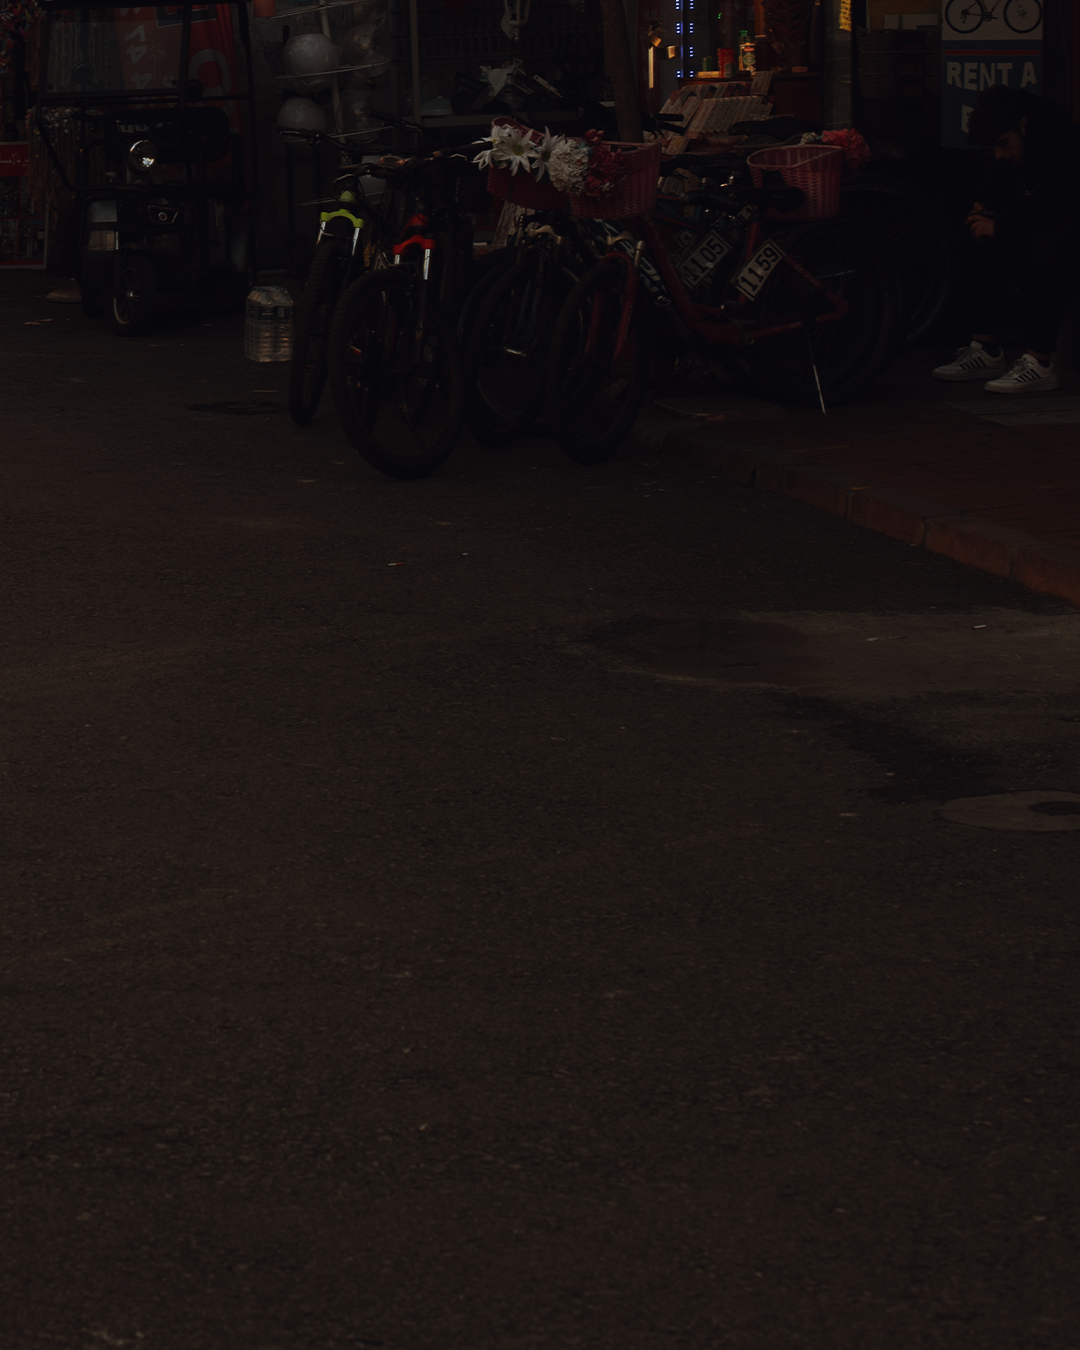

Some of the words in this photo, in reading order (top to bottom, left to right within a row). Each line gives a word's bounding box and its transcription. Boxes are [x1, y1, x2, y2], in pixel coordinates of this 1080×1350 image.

[946, 61, 1013, 92] RENT
[1020, 61, 1038, 88] A
[683, 238, 724, 282] 1105
[740, 247, 779, 292] 1159
